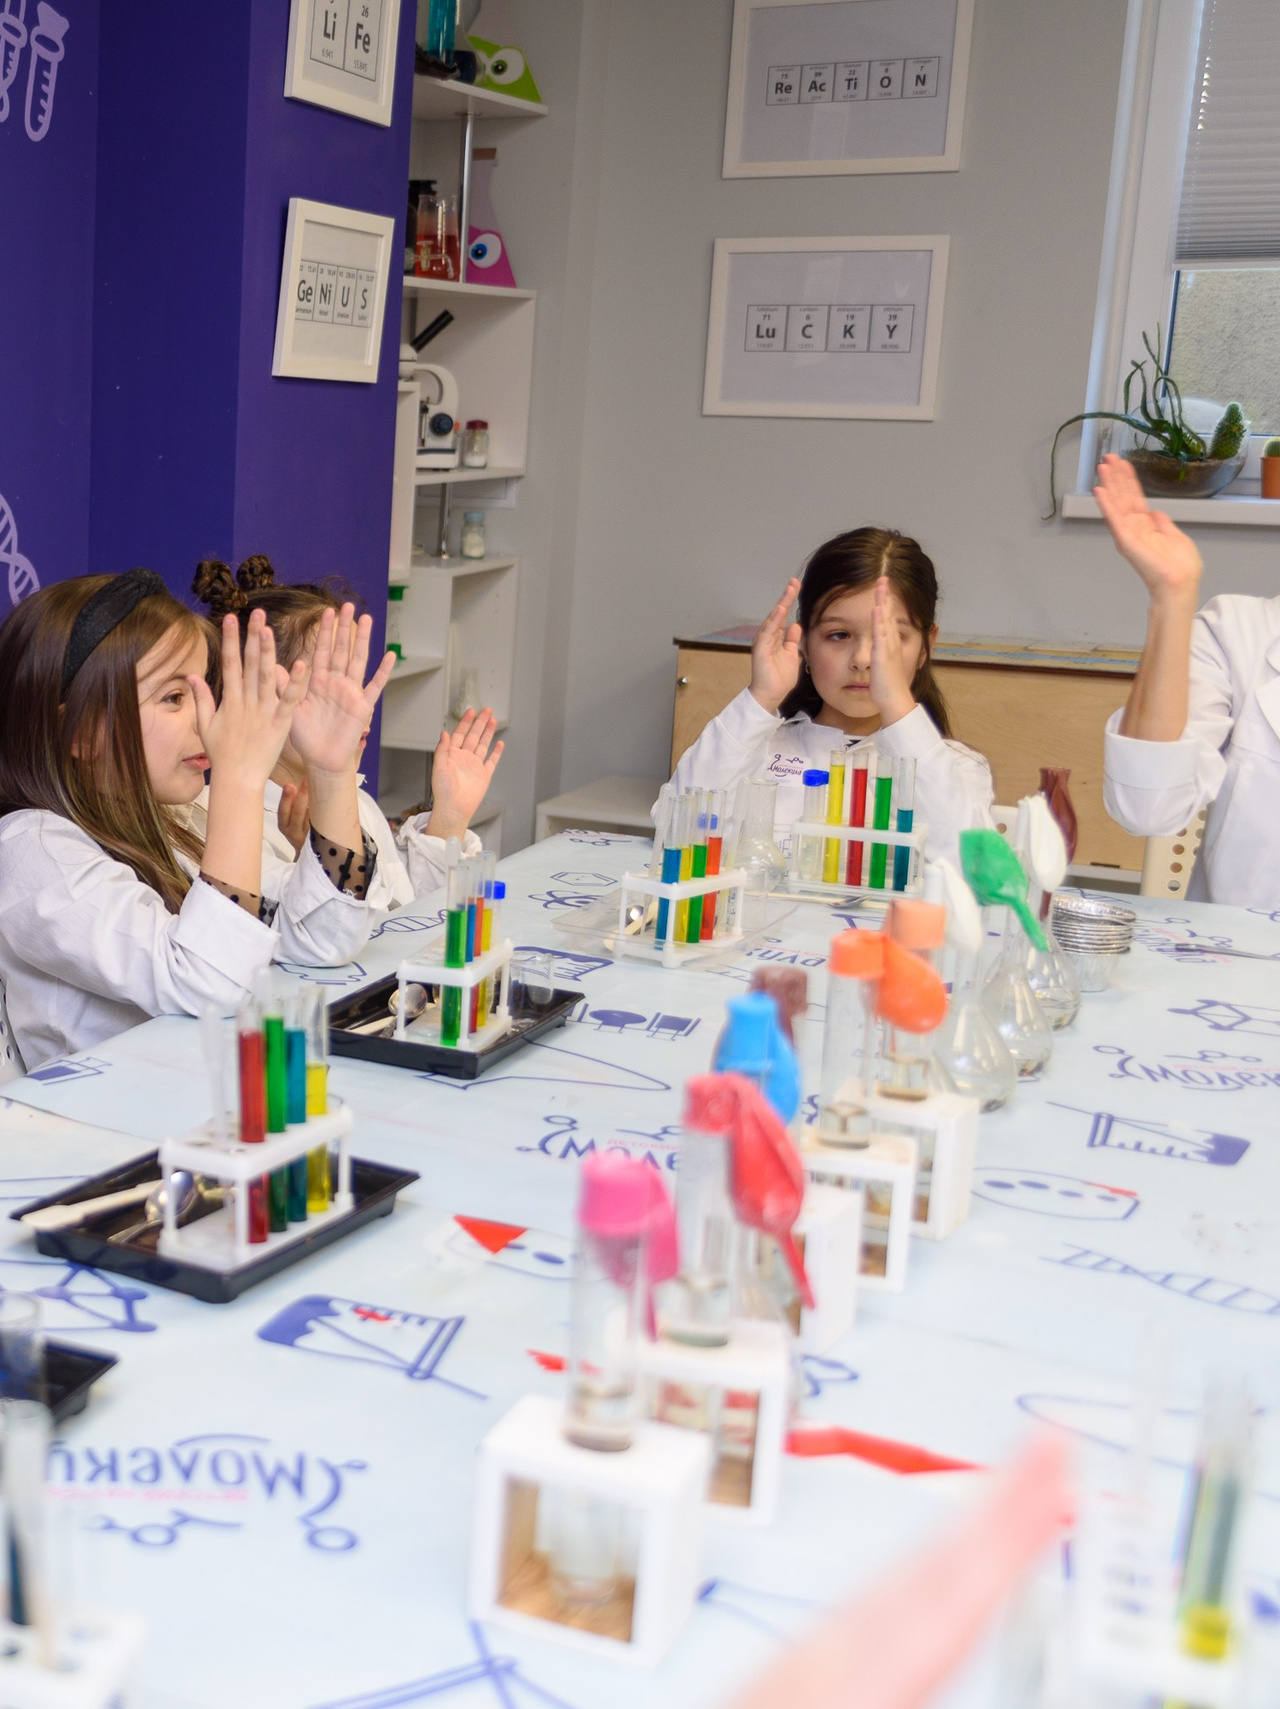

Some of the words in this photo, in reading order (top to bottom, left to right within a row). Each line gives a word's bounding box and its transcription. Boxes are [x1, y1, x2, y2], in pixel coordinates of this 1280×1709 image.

[361, 5, 369, 18] 26
[323, 10, 337, 41] Li
[354, 22, 371, 54] Fe
[774, 82, 793, 95] Re
[808, 80, 827, 93] Ac
[844, 77, 858, 91] Ti
[879, 75, 892, 89] O
[914, 73, 927, 87] N
[297, 279, 313, 303] Ge
[319, 282, 332, 306] Ni
[341, 285, 350, 308] U
[360, 288, 368, 310] S
[756, 324, 776, 339] Lu
[801, 324, 813, 339] C
[843, 324, 855, 339] K
[886, 324, 898, 339] Y
